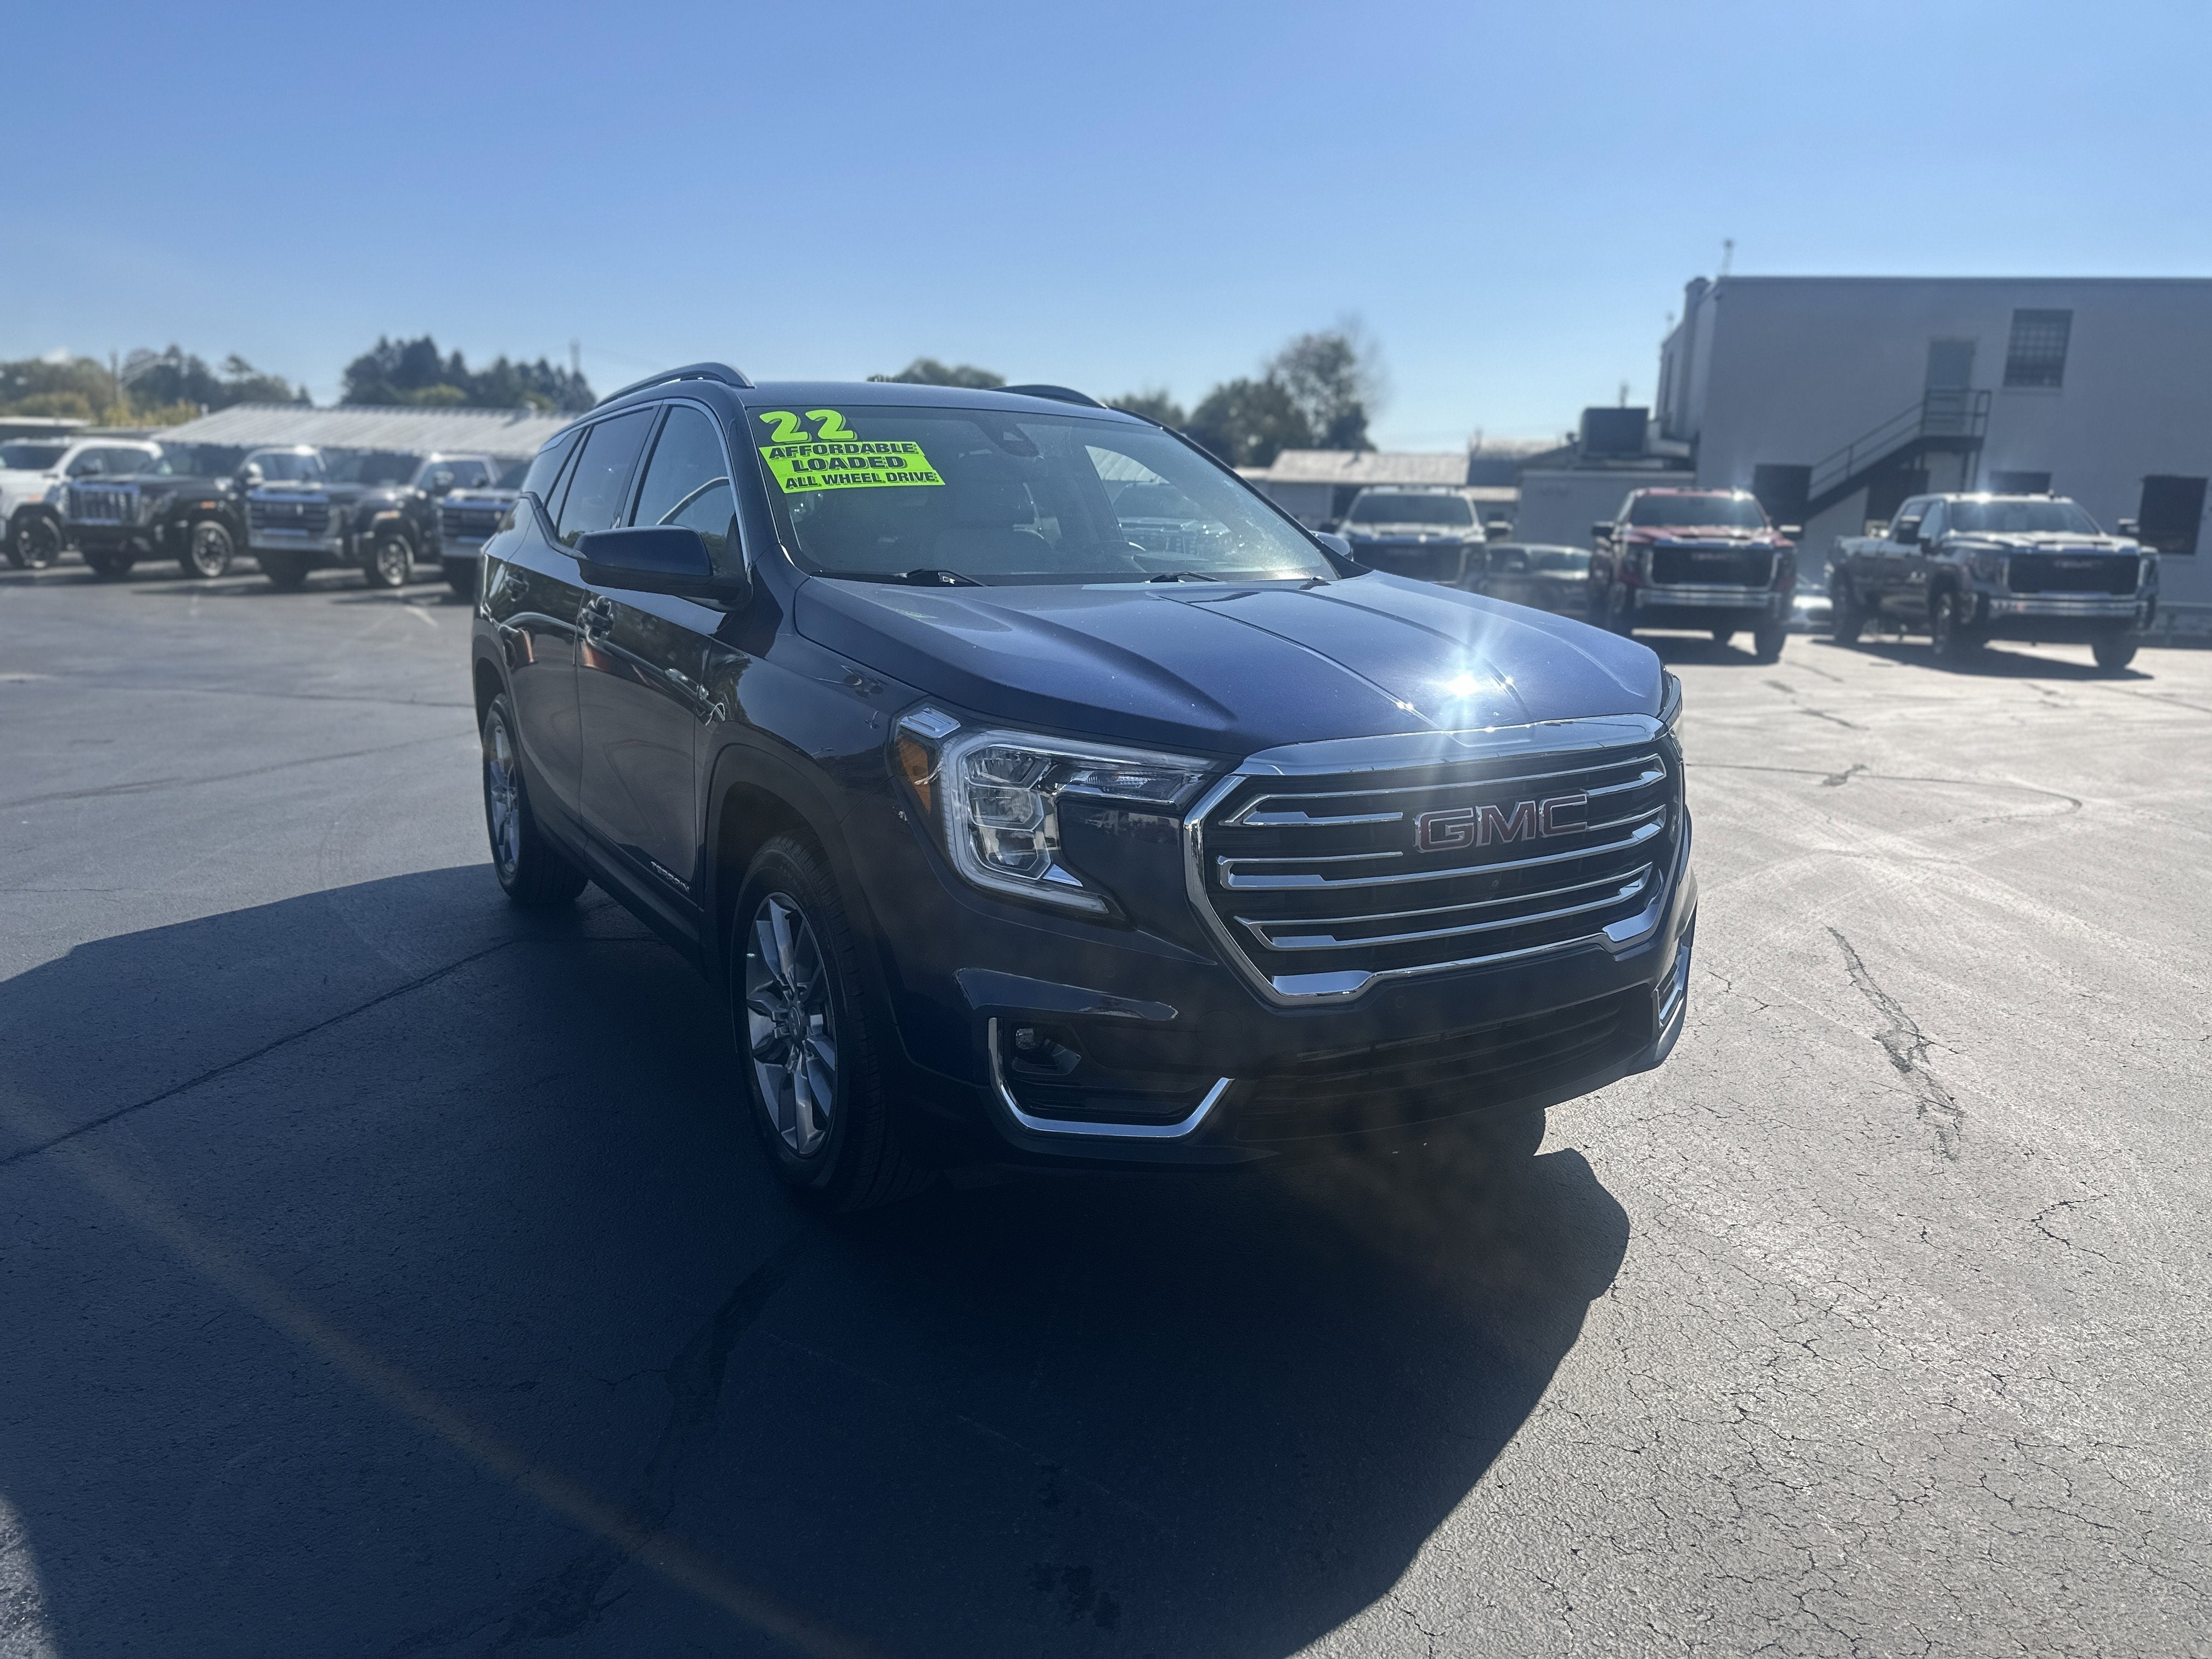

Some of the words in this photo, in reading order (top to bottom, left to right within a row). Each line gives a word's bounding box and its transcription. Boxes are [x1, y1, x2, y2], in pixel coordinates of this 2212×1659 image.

[759, 409, 857, 443] 22
[769, 443, 919, 459] AFFORDABLE
[792, 456, 907, 473] LOADED
[786, 476, 821, 489] ALL
[821, 472, 885, 485] WHEEL
[887, 472, 939, 483] DRIVE
[1413, 793, 1587, 853] GMC
